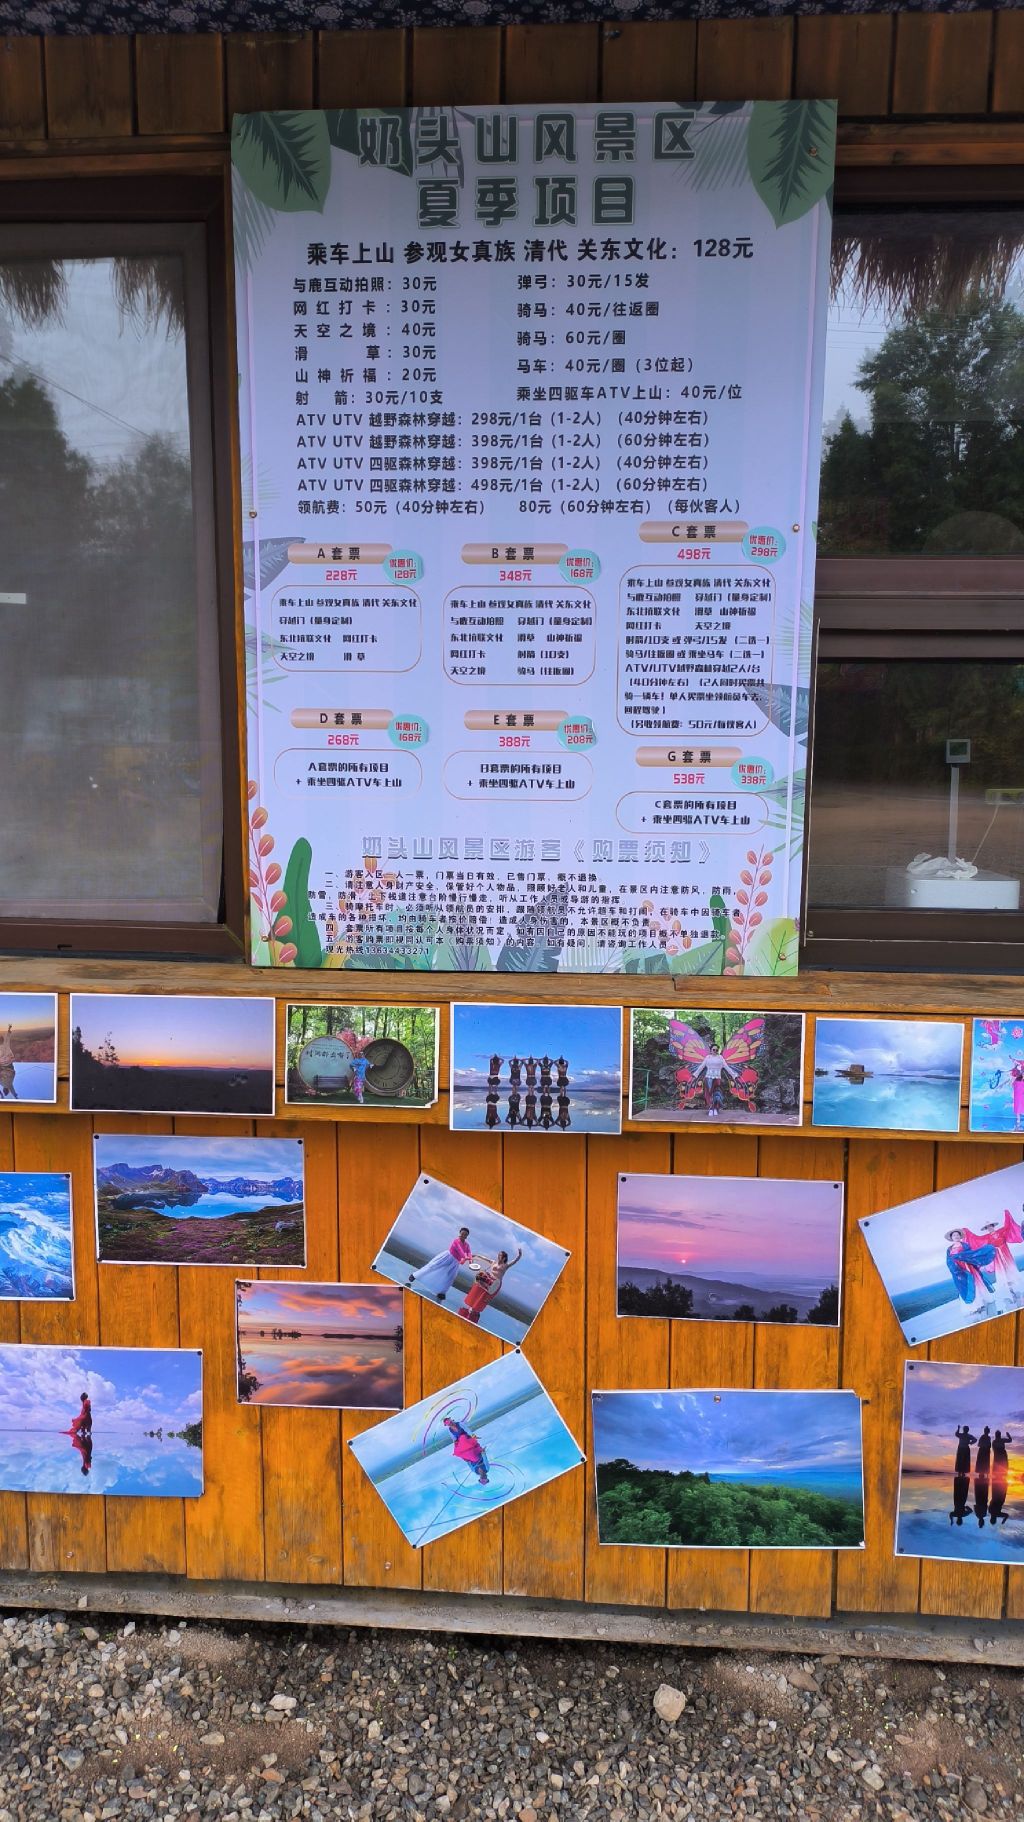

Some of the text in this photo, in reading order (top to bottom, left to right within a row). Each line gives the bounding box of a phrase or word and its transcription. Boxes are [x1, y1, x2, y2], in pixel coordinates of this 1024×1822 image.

[358, 110, 697, 167] 奶头山风景区
[416, 175, 637, 229] 夏季项目
[306, 236, 755, 265] 乘车上山 参观女真族 清代 关东文化：128元
[293, 276, 437, 293] 与鹿互动拍照：30元
[517, 272, 650, 290] 弹弓：30元/15发
[517, 301, 659, 318] 骑马：40元/往返圈
[516, 329, 626, 346] 骑马：60元/圈
[297, 414, 326, 426] ATV
[333, 414, 363, 426] UTV
[297, 435, 327, 448] ATV
[333, 434, 363, 448] UTV
[297, 457, 327, 470] ATV
[333, 456, 363, 470] UTV
[298, 479, 327, 492] ATV
[334, 478, 363, 492] UTV
[672, 525, 716, 538] C套票
[317, 547, 361, 561] A套票
[491, 547, 535, 561] B套票
[677, 548, 711, 560] 498元
[751, 546, 778, 557] 298元
[325, 569, 358, 581] 228元
[394, 569, 417, 579] 128元
[500, 569, 532, 581] 348元
[570, 568, 594, 578] 168元
[672, 635, 681, 645] 或
[677, 649, 686, 658] 或
[319, 712, 362, 725] D套票
[493, 713, 535, 727] E套票
[327, 734, 360, 745] 268元
[399, 733, 421, 742] 168元
[499, 735, 531, 747] 388元
[567, 734, 593, 744] 208元
[667, 750, 712, 763] G套票
[308, 762, 389, 773] A套票的所有项目
[673, 773, 705, 785] 538元
[741, 775, 767, 785] 338元
[654, 800, 737, 810] C套票的所有项目
[362, 836, 711, 864] 奶头山风景区游客《购票须知》
